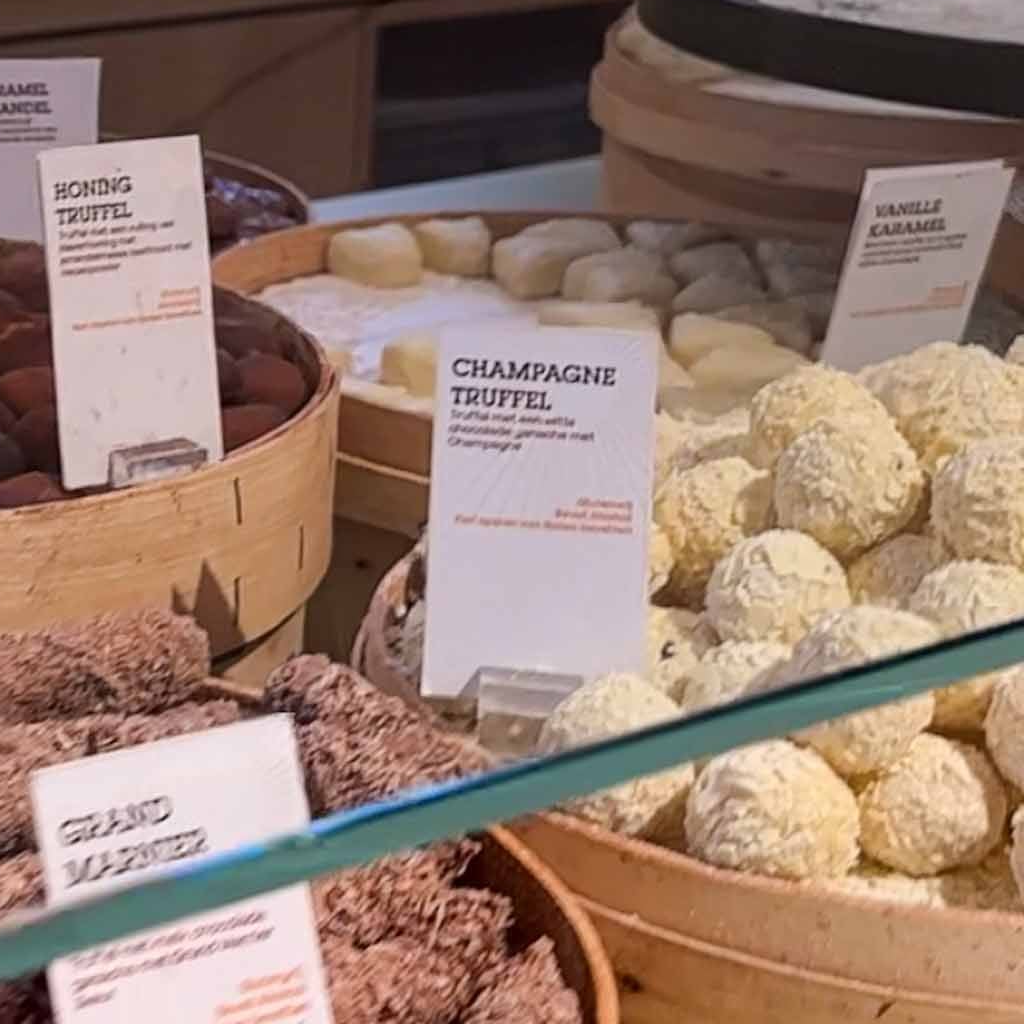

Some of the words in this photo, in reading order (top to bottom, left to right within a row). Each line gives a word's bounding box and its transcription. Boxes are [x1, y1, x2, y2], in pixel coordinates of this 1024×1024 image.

[53, 176, 132, 201] HONING
[55, 202, 133, 225] TRUFFEL
[876, 198, 943, 219] VANILLE
[867, 218, 946, 238] KARAMEL
[451, 357, 617, 387] CHAMPAGNE
[450, 386, 552, 411] TRUFFEL
